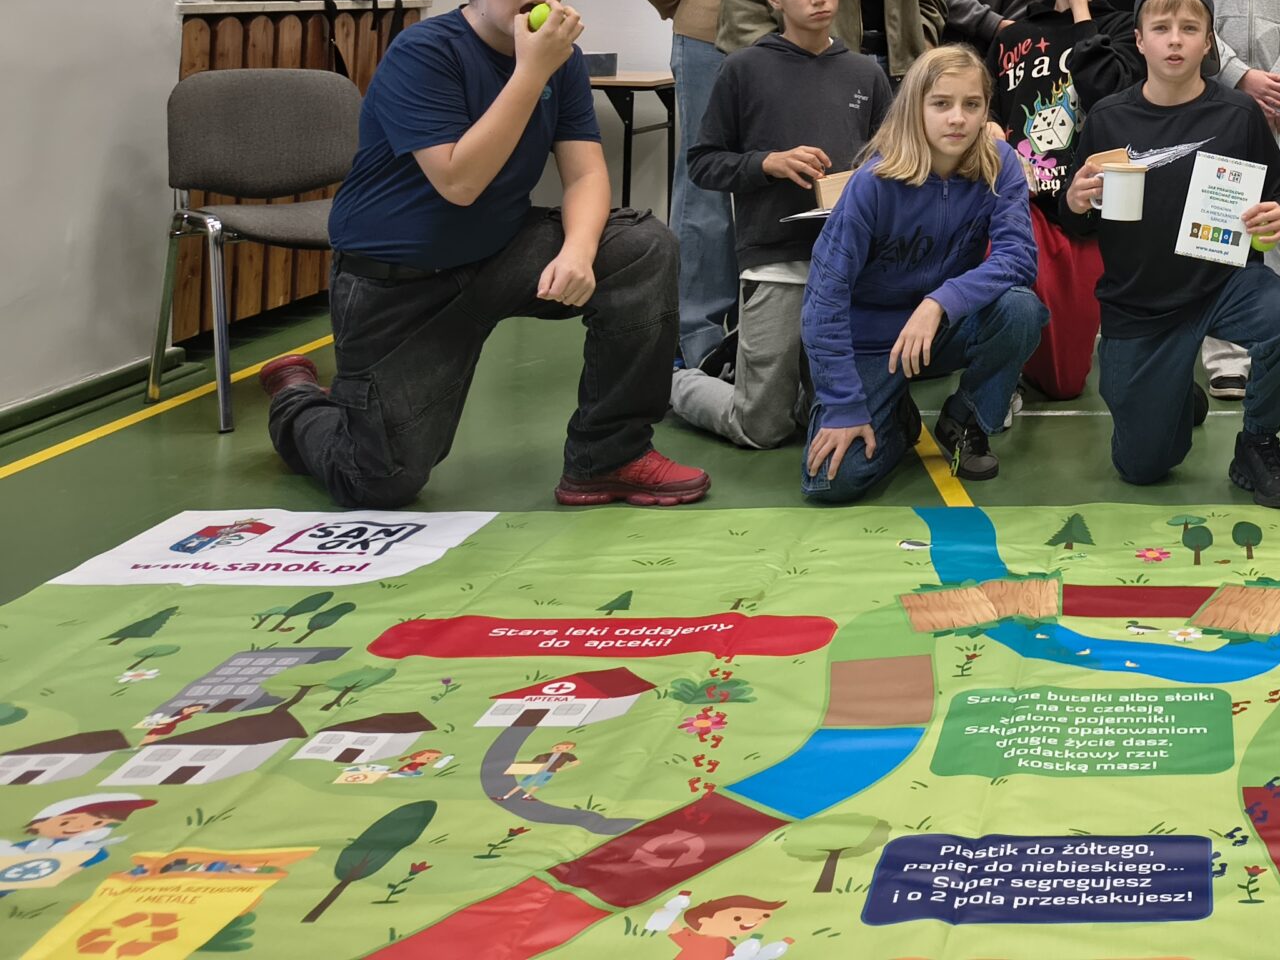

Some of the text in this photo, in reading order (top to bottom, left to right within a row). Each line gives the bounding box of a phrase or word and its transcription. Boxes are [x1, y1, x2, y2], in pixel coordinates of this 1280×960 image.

[1006, 61, 1025, 91] is
[1032, 56, 1050, 78] a
[1036, 178, 1060, 197] lay
[130, 560, 370, 574] www.sanok.pl
[488, 622, 735, 638] Stare leki oddajemy
[538, 637, 674, 650] do apteki!
[967, 691, 1215, 705] Szklane butelki albo słoiki
[1035, 703, 1059, 712] na
[1066, 704, 1087, 713] to
[1093, 703, 1164, 715] czekają
[999, 713, 1175, 726] zielone pojemniki!
[964, 724, 1208, 737] Szklanym opakowaniom
[995, 736, 1173, 749] drugie życie dasz,
[1003, 747, 1169, 760] dodatkowy rzut
[1017, 758, 1157, 773] kostką masz!
[940, 842, 1155, 860] Plastik do żółtego,
[903, 860, 1185, 875] papier do niebieskiego...
[932, 875, 1152, 892] Super segregujesz
[892, 890, 1193, 909] i o 2 pola przeskakujesz!
